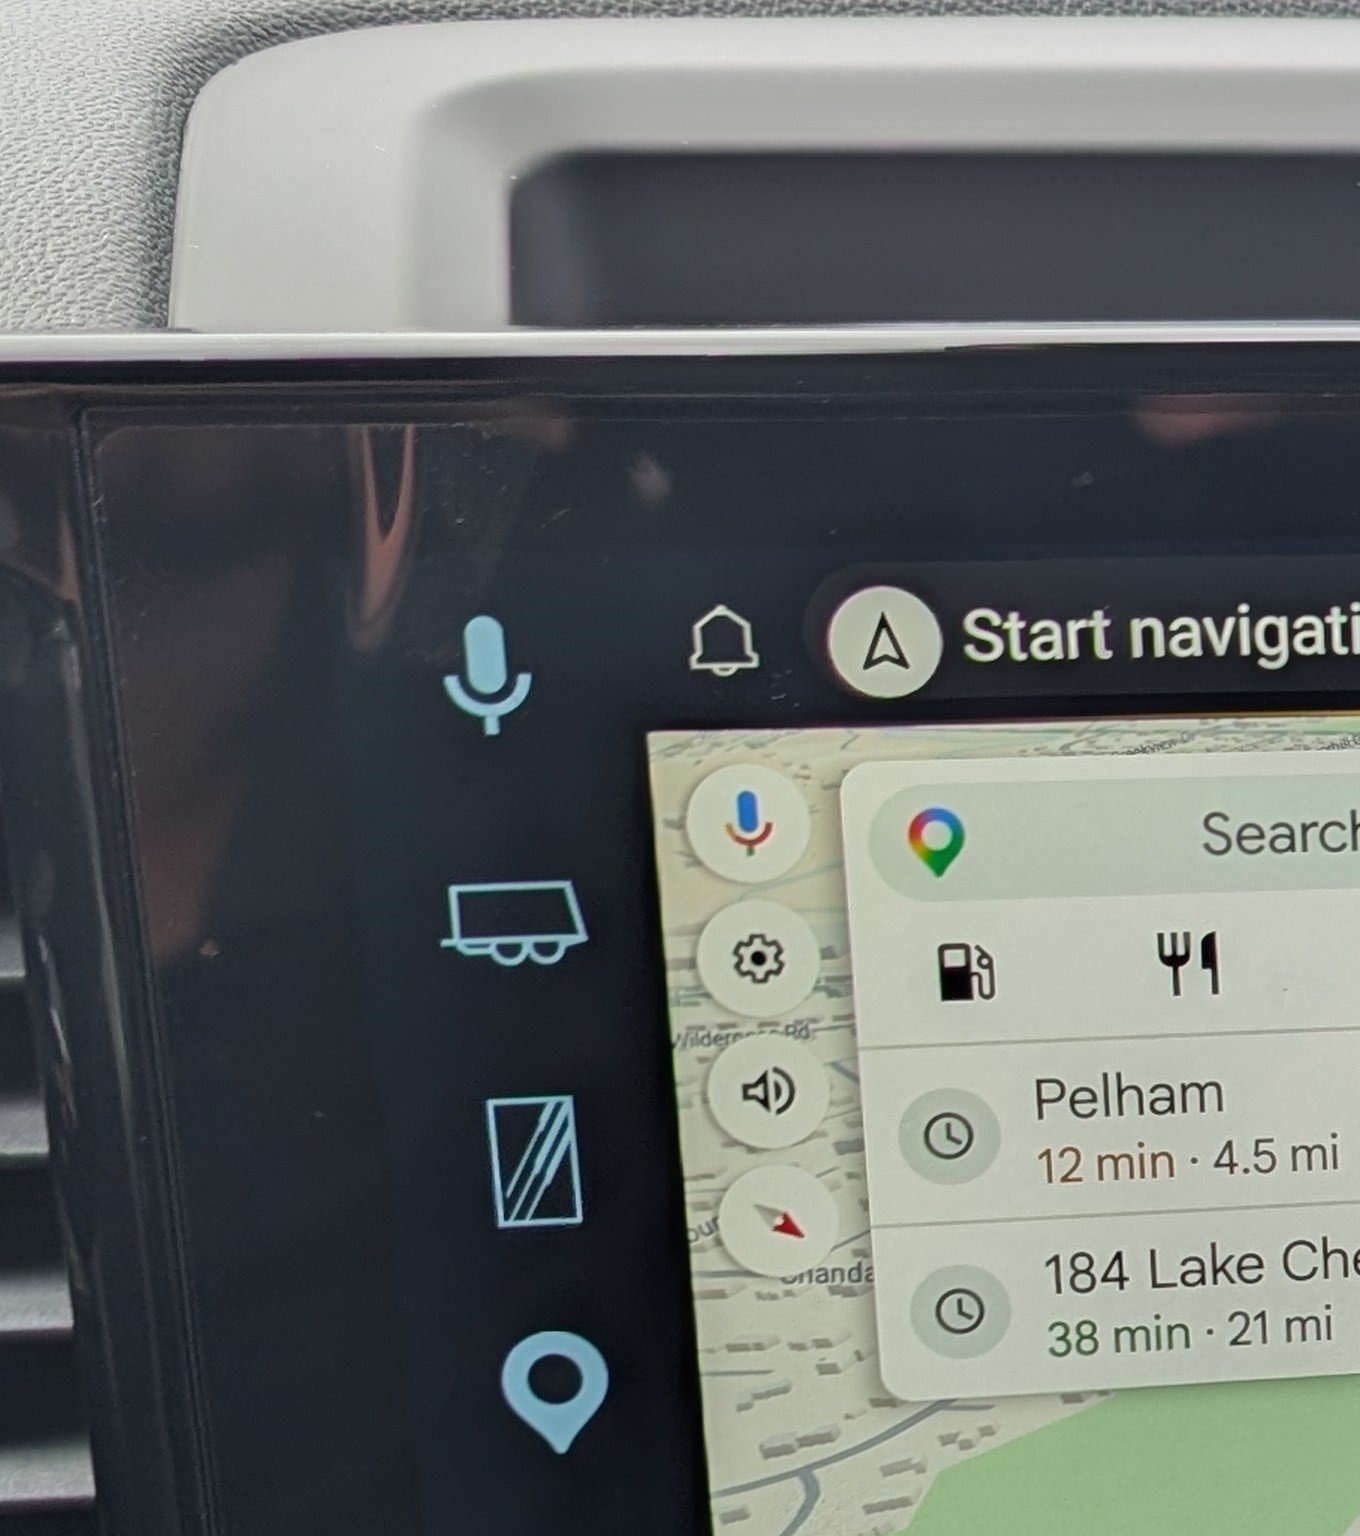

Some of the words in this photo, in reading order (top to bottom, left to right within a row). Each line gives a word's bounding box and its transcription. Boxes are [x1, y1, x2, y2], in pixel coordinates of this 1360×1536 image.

[963, 606, 1112, 663] Start
[1036, 1072, 1225, 1121] Pelham
[1037, 1146, 1084, 1184] 12
[1097, 1141, 1176, 1182] min
[1213, 1137, 1277, 1176] 4.5
[1290, 1132, 1340, 1172] mi
[1044, 1250, 1131, 1295] 184
[1150, 1240, 1264, 1289] Lake
[1048, 1318, 1099, 1358] 38
[1113, 1313, 1192, 1354] min
[1228, 1310, 1269, 1347] 21
[1285, 1304, 1333, 1343] mi
